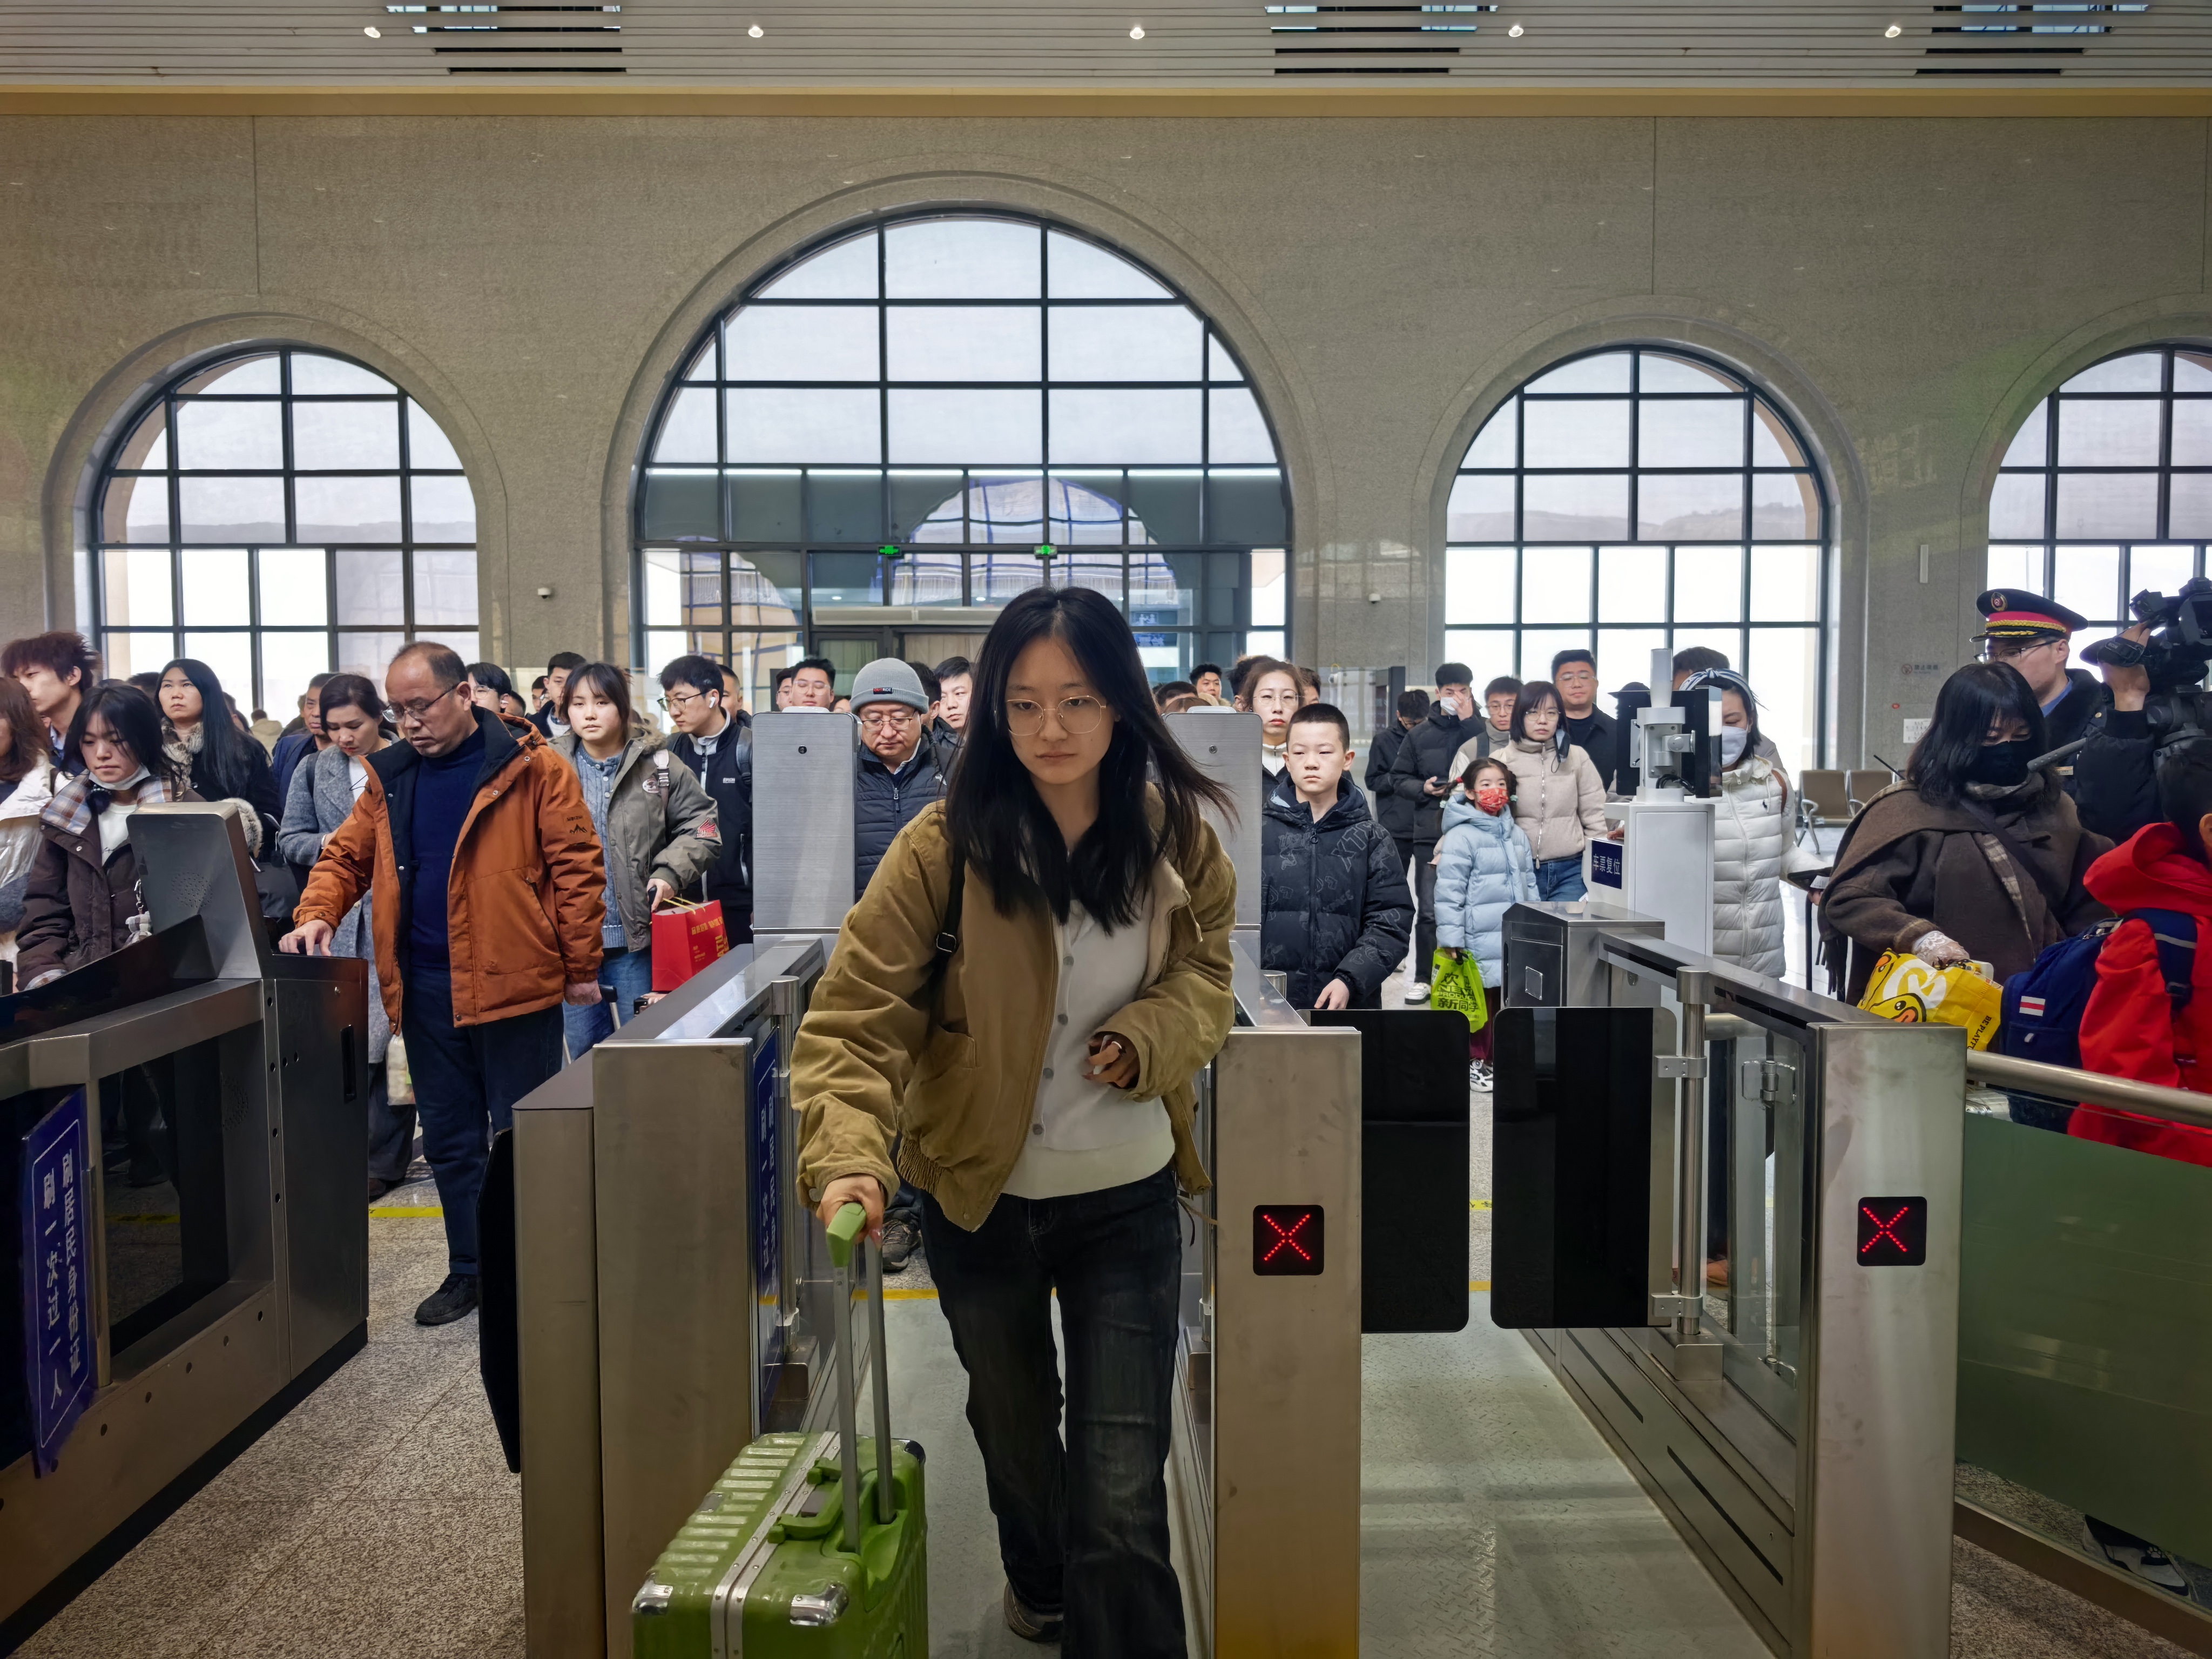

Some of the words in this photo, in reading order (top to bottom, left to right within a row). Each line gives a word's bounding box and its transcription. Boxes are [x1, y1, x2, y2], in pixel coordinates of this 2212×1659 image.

[1593, 853, 1621, 875] 车票复位
[1438, 997, 1479, 1012] 新同学
[1981, 1015, 1992, 1026] BE
[62, 1148, 80, 1378] 刷居民身份证
[44, 1168, 63, 1410] 刷一次过一人
